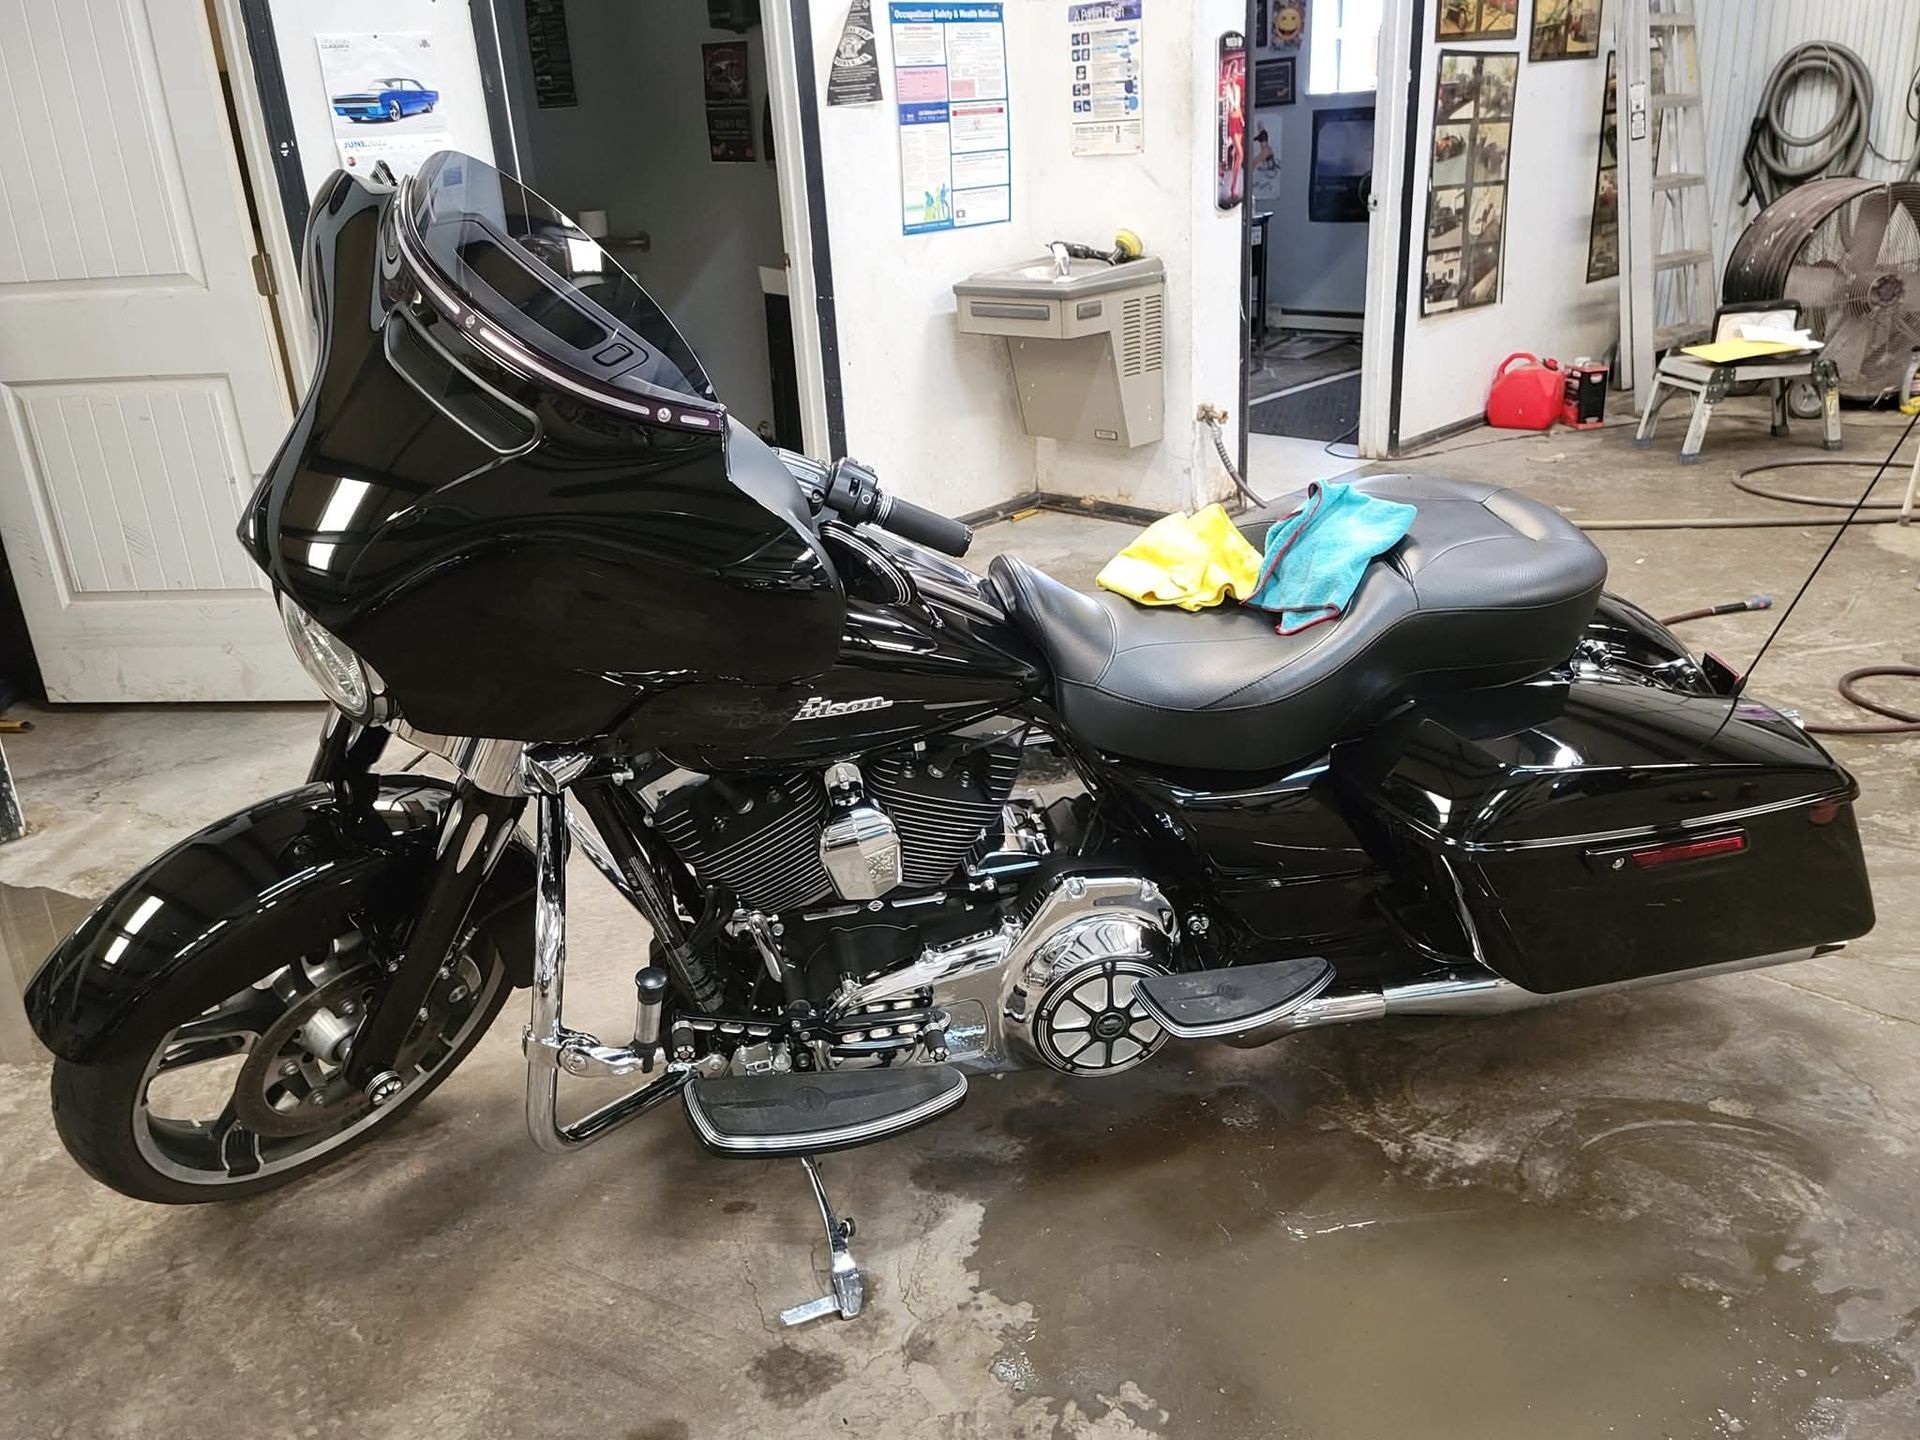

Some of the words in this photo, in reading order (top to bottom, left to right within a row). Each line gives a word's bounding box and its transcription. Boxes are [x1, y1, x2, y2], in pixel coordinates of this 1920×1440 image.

[894, 10, 934, 20] Occupational
[934, 9, 953, 20] Safety
[953, 9, 959, 18] &
[344, 140, 367, 149] JUNE
